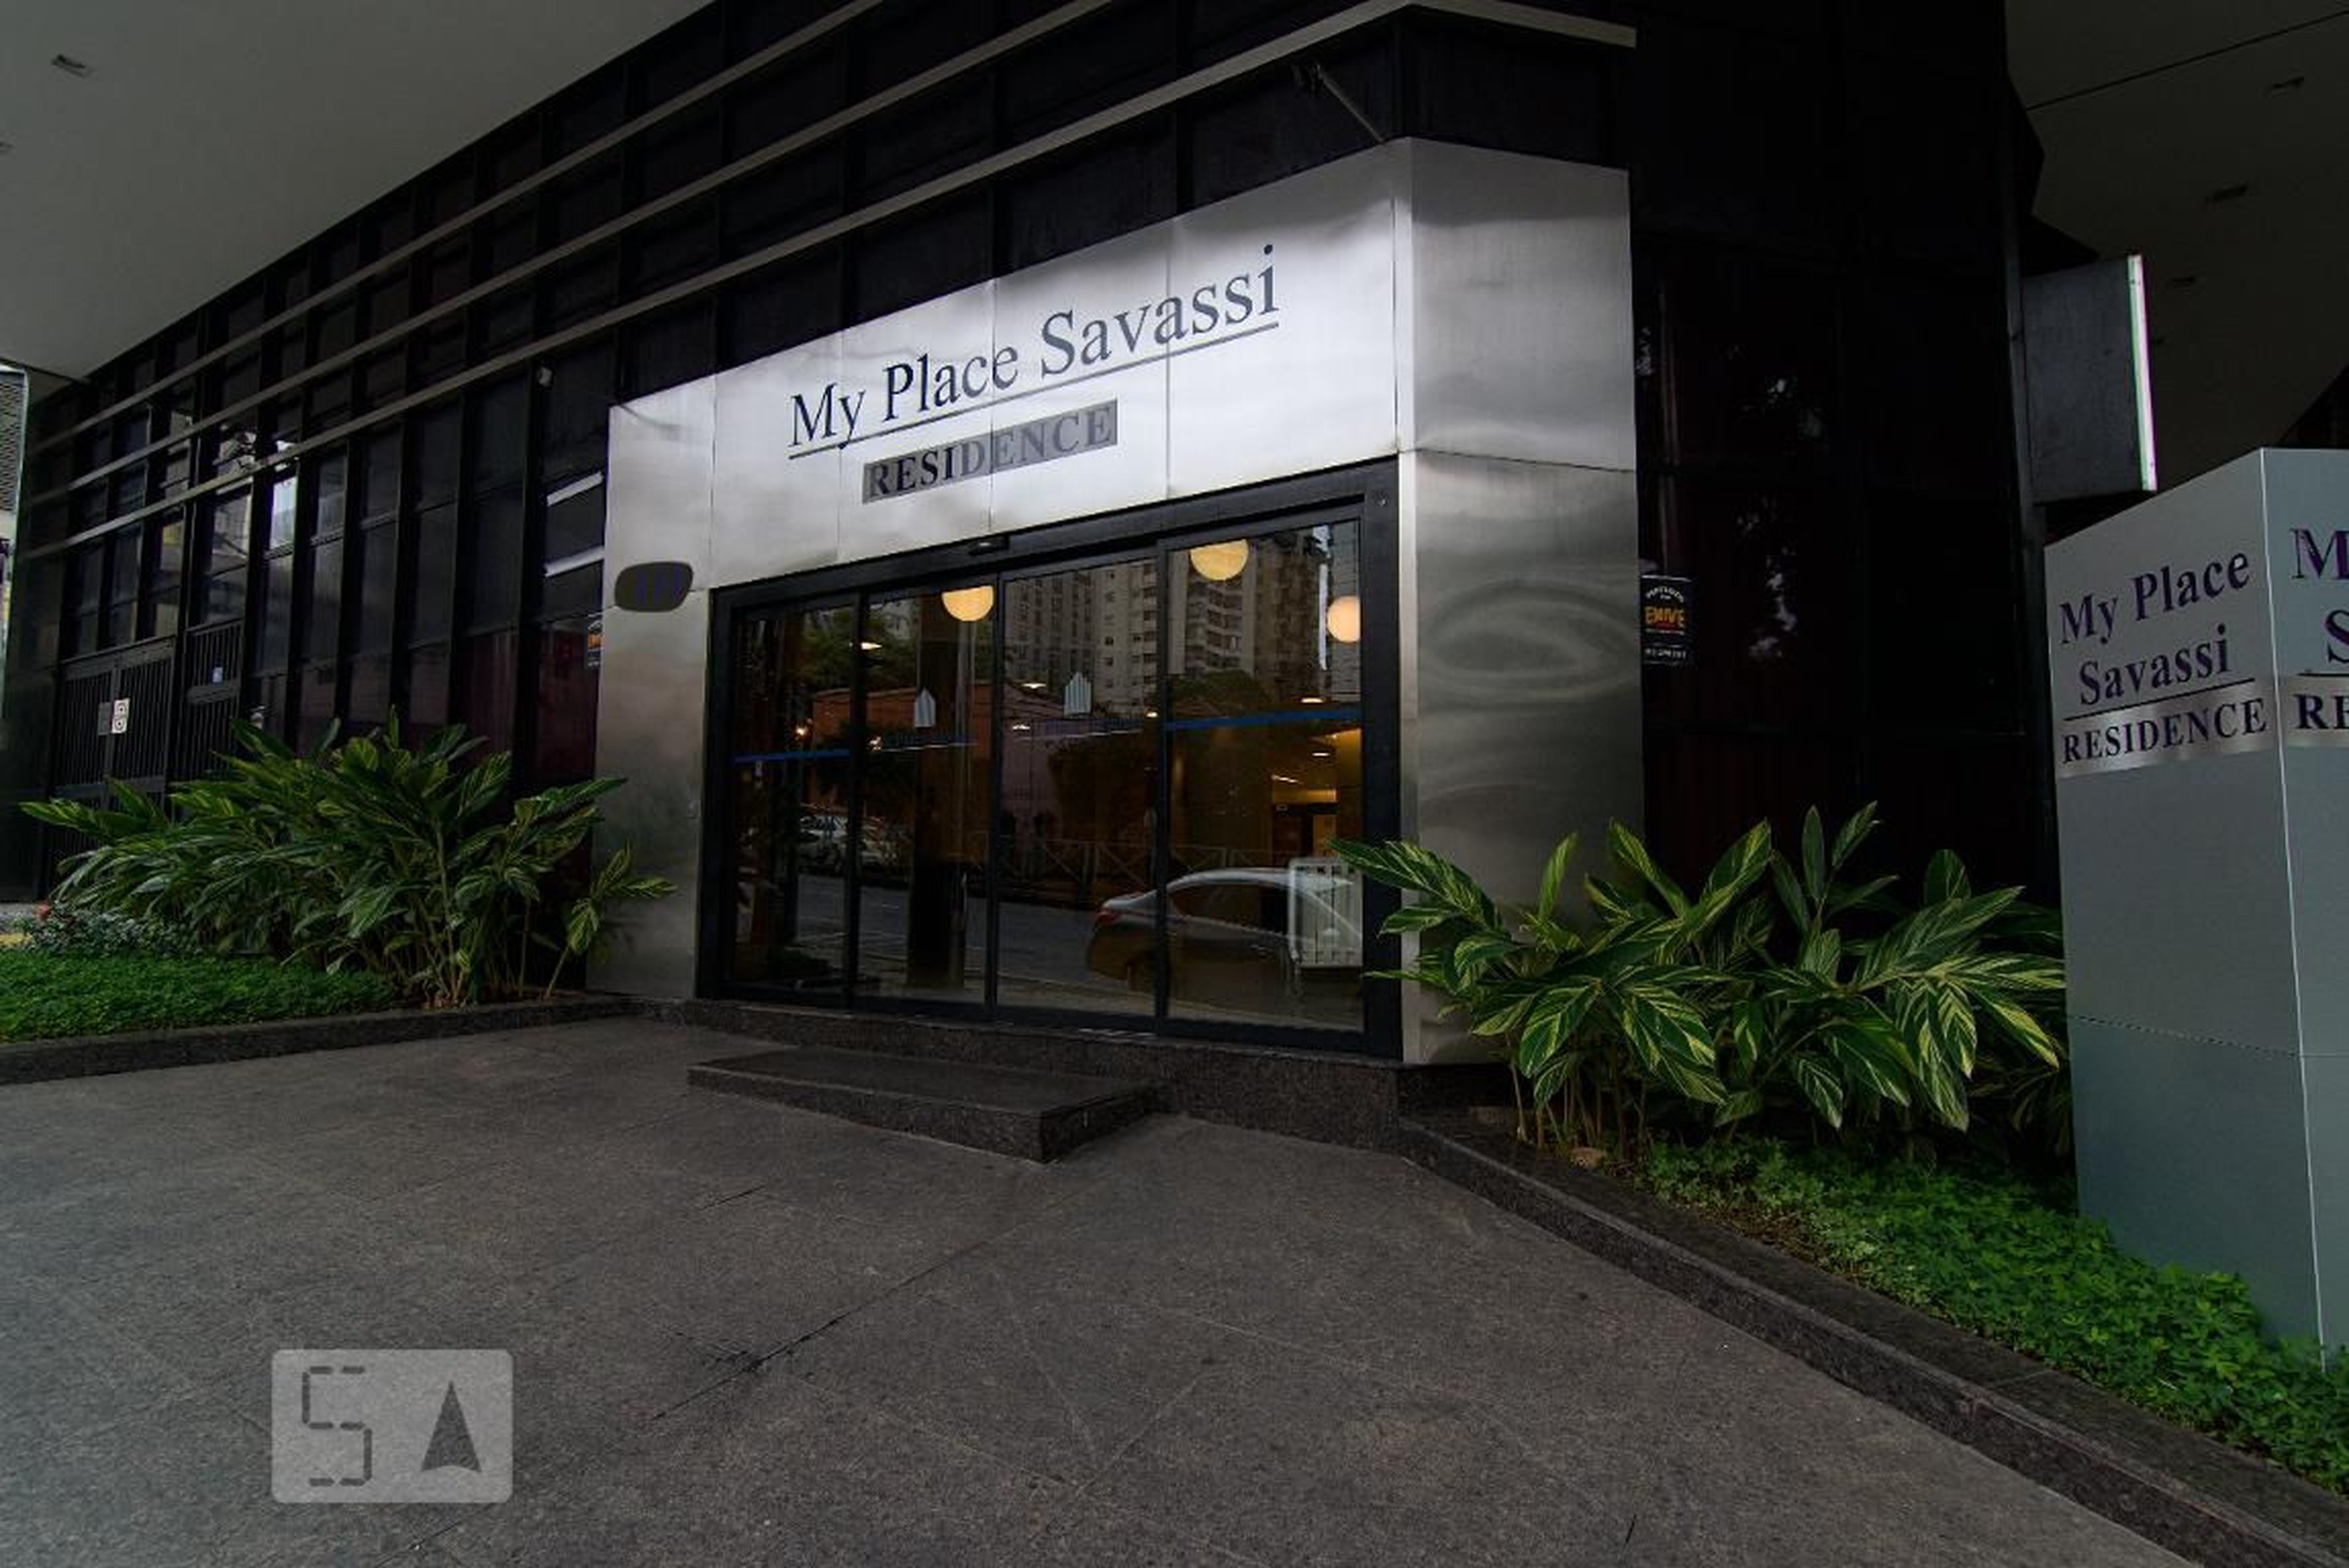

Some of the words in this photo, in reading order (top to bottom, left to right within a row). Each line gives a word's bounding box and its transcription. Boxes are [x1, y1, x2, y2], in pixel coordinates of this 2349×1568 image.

[790, 382, 864, 449] My
[883, 353, 1019, 421] Place
[1040, 244, 1279, 379] Savassi
[866, 405, 1113, 497] RESIDENCE
[2060, 593, 2118, 645] My
[2132, 553, 2249, 621] Place
[2080, 623, 2232, 705] Savassi
[2063, 698, 2266, 764] RESIDENCE
